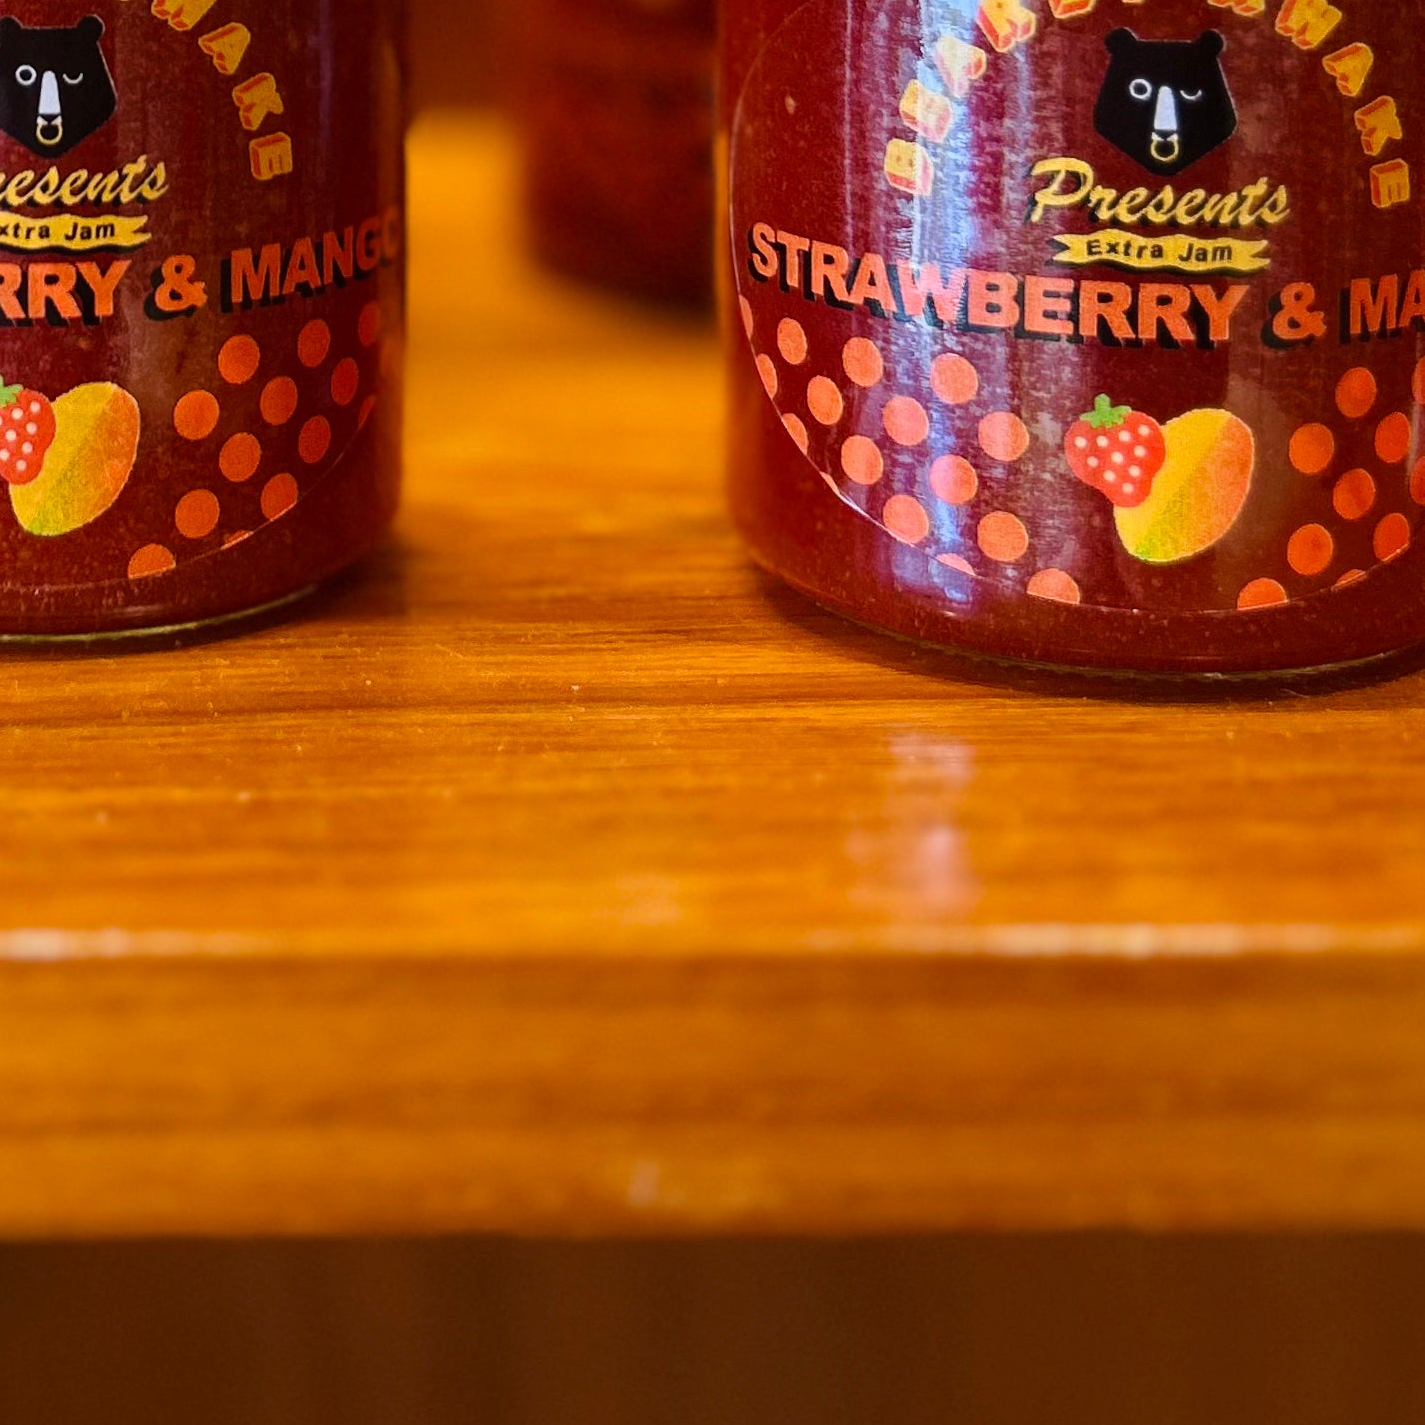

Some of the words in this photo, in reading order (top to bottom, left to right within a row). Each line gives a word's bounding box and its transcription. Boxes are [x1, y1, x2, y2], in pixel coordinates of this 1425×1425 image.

[1027, 156, 1292, 227] Presents
[62, 220, 117, 243] Jam
[1085, 238, 1165, 262] Extra
[1178, 240, 1233, 264] Jam
[149, 254, 208, 319] &
[747, 221, 1249, 343] STRAWBERRY
[1267, 281, 1326, 345] &
